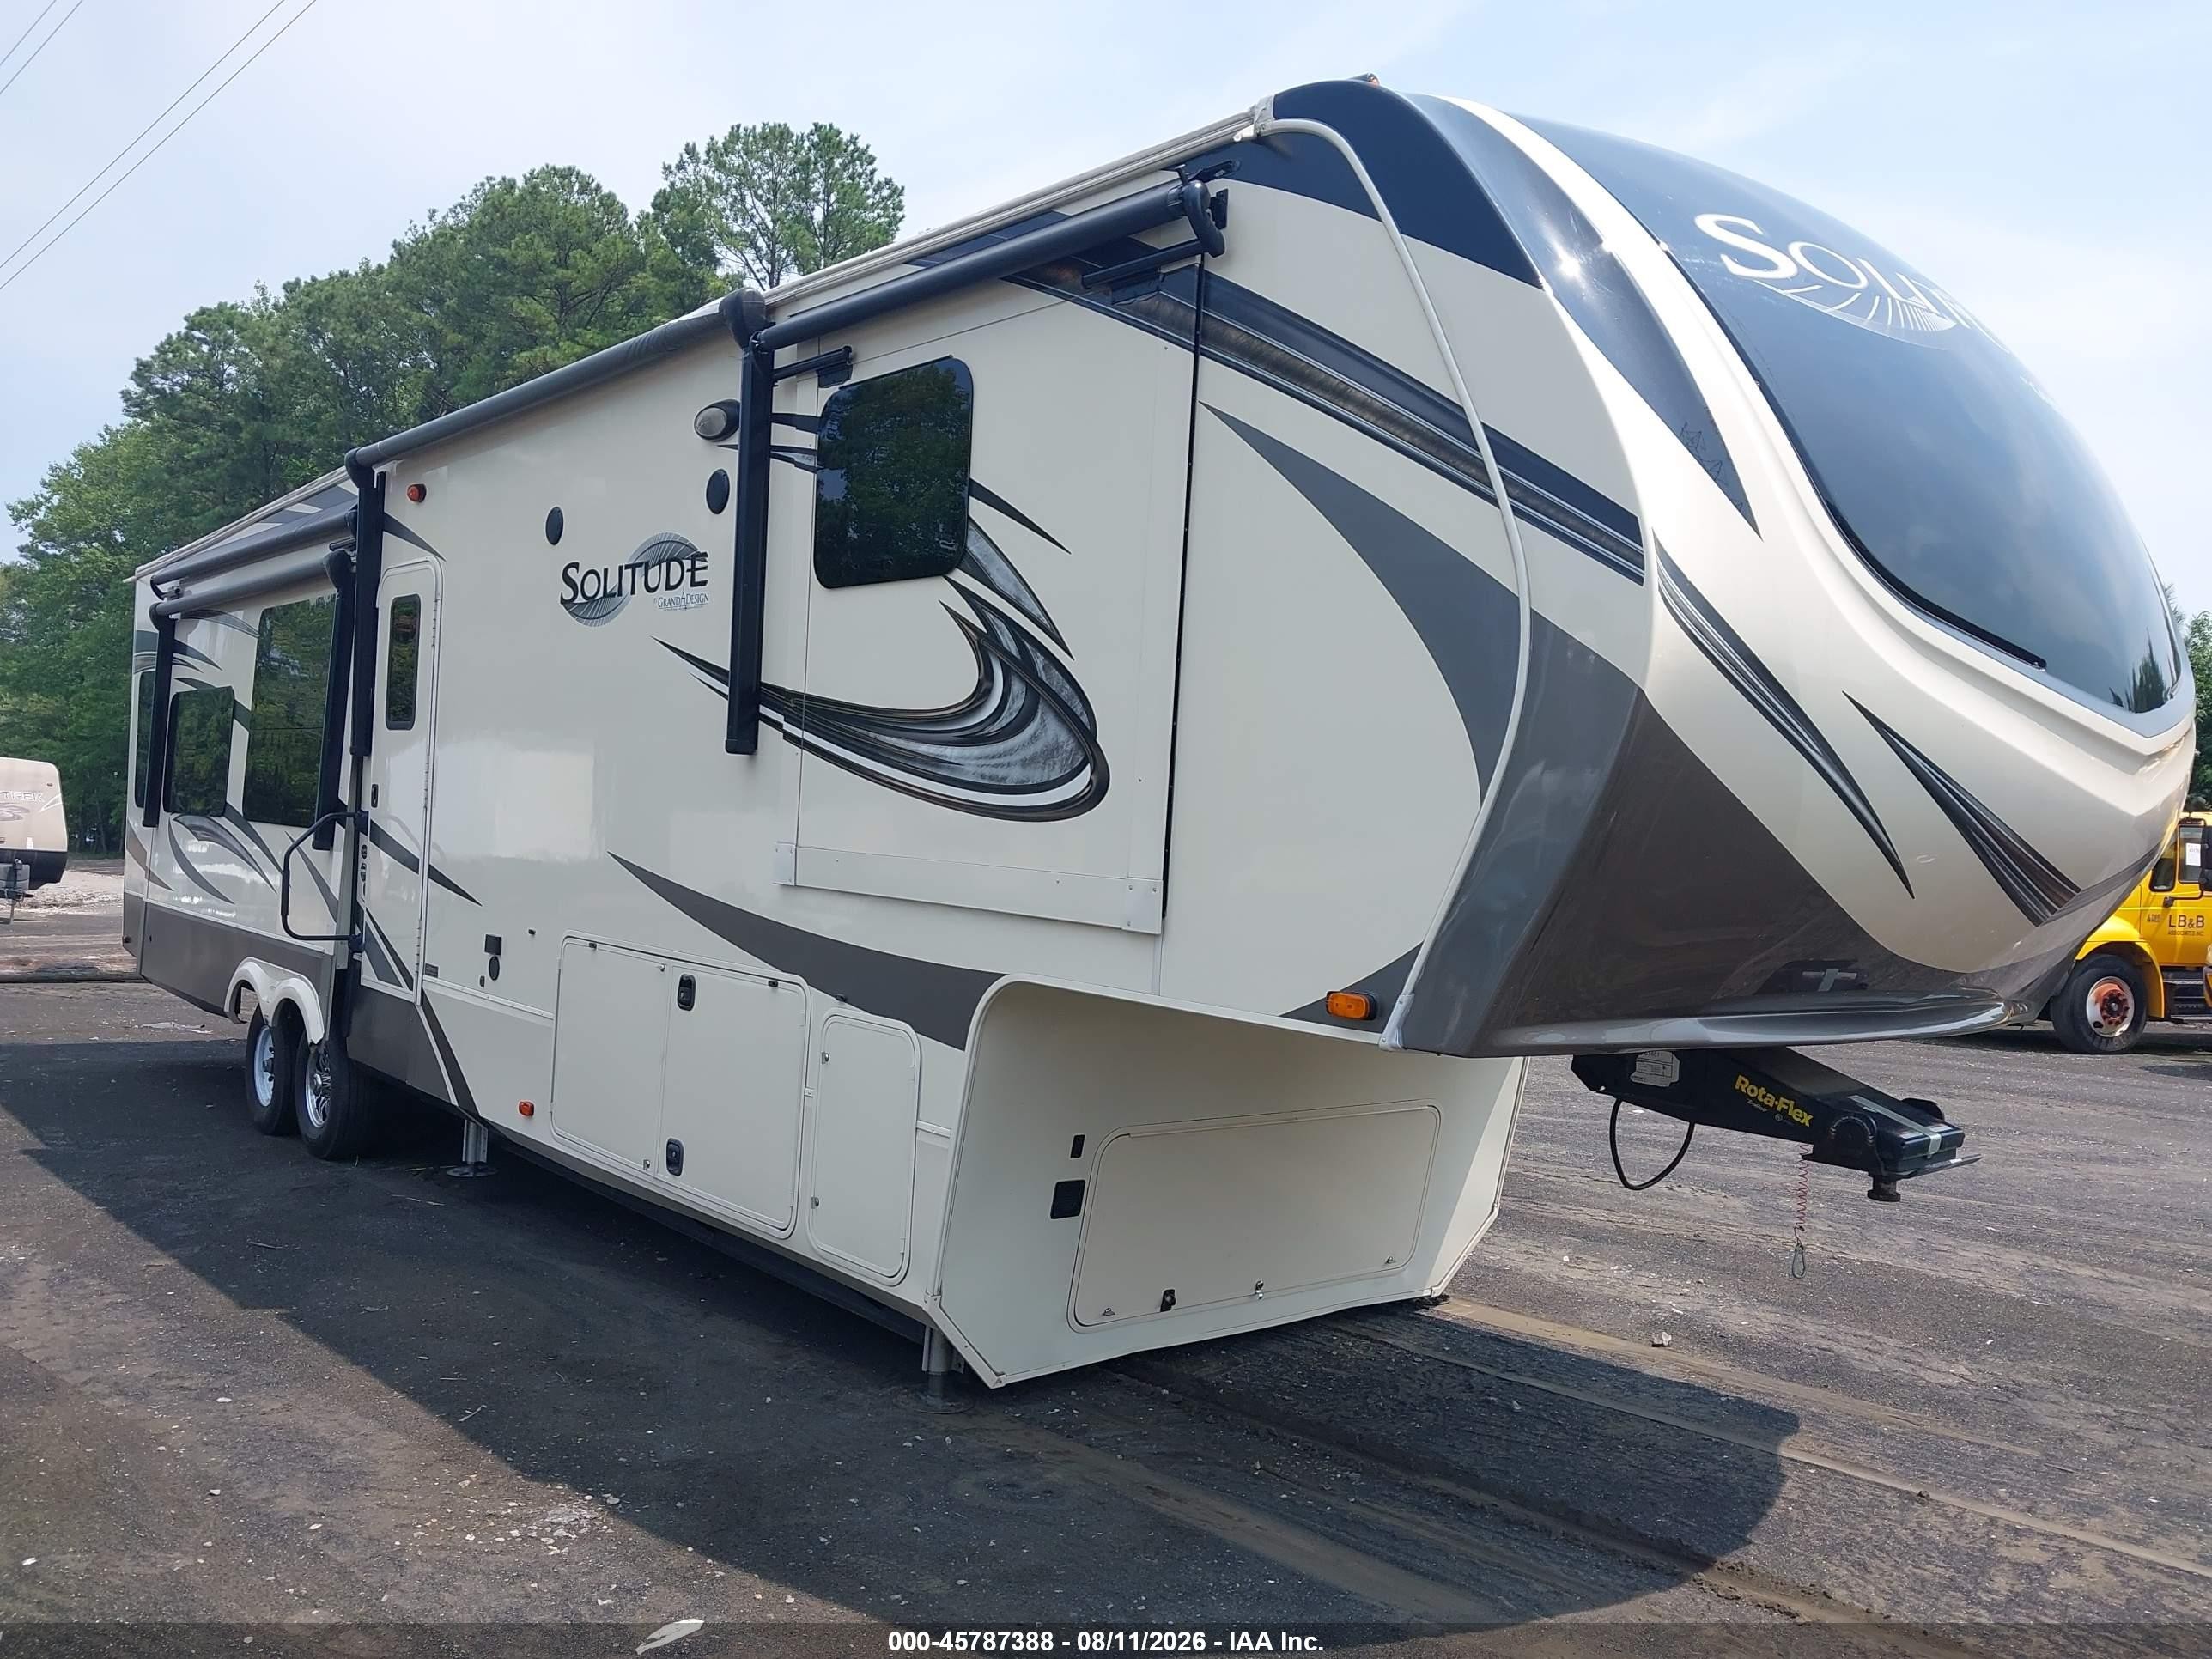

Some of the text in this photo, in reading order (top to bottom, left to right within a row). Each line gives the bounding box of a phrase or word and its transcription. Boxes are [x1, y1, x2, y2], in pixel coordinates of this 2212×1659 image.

[560, 551, 708, 605] SOLITUDE
[685, 592, 710, 605] DESIGN
[2168, 915, 2205, 928] LB&B
